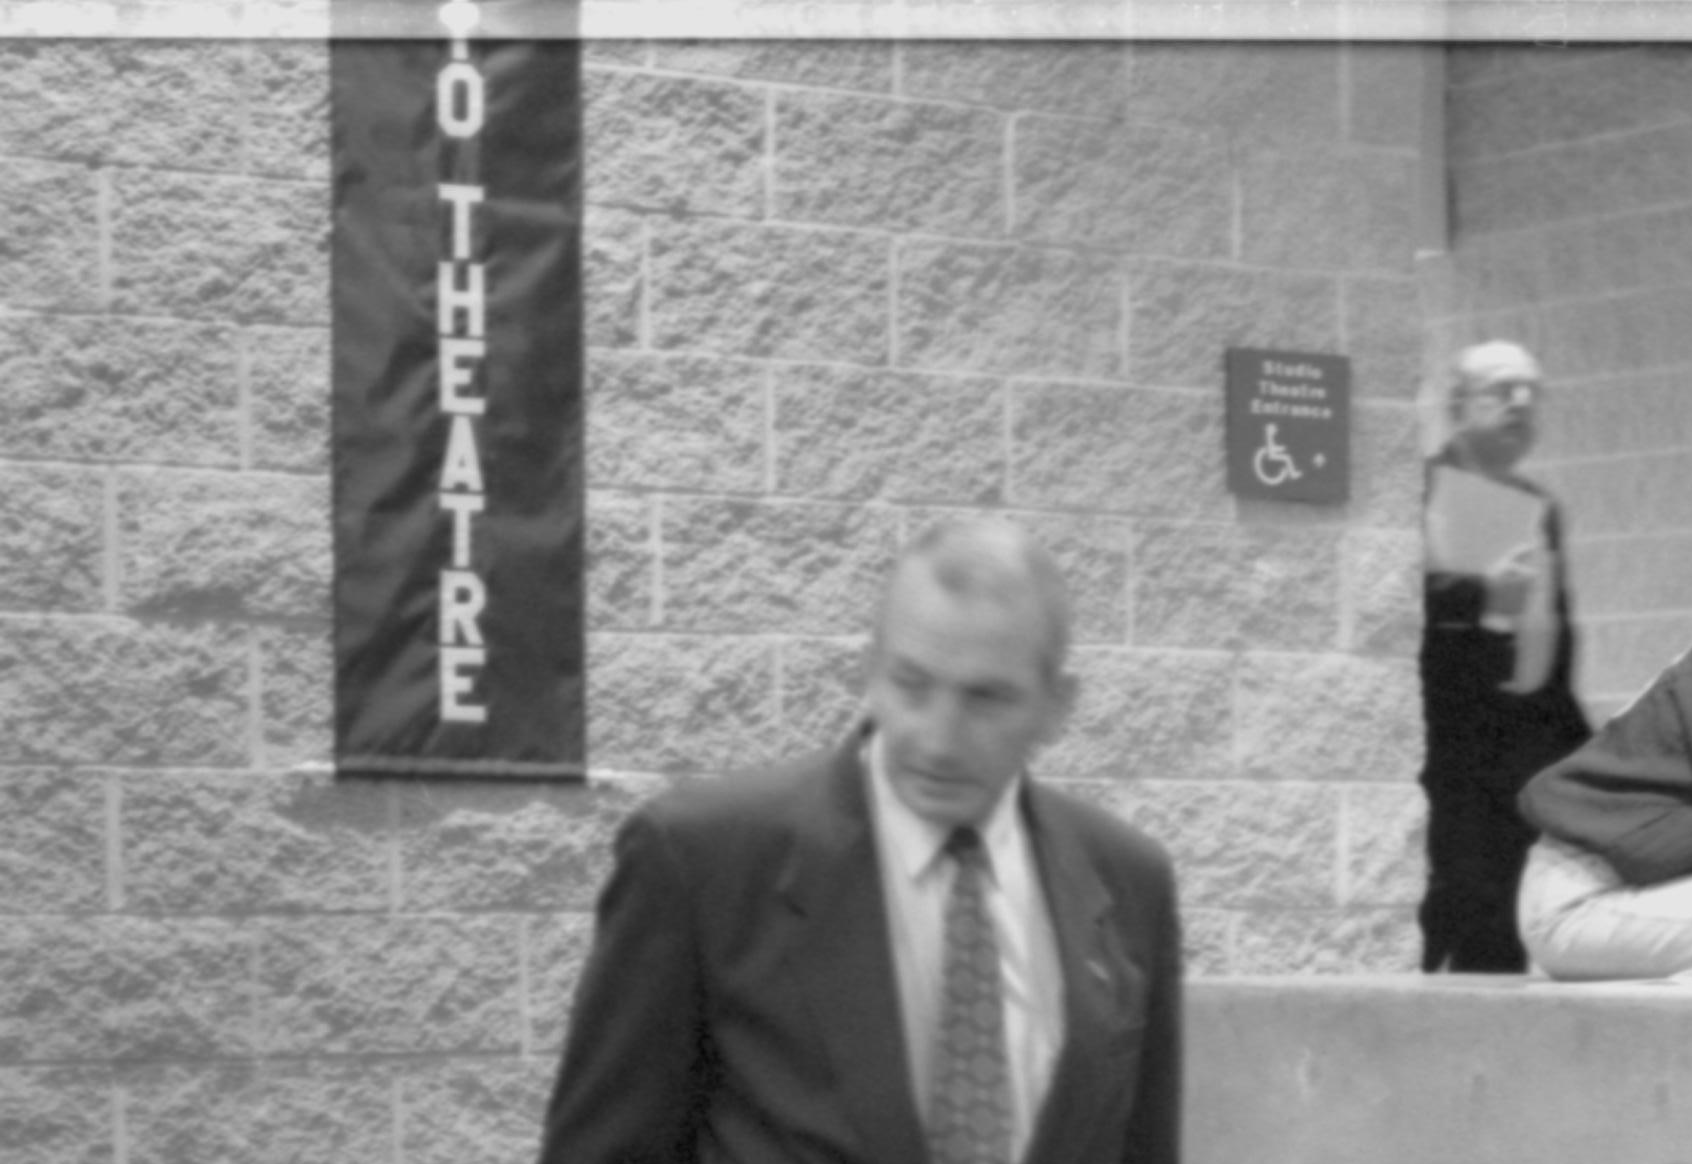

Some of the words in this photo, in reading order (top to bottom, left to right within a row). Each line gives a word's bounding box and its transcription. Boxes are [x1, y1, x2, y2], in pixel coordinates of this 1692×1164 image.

[1262, 360, 1323, 379] Studio
[1258, 380, 1326, 399] Theatre
[1251, 398, 1333, 419] Entrance
[437, 183, 487, 722] THEATRE
